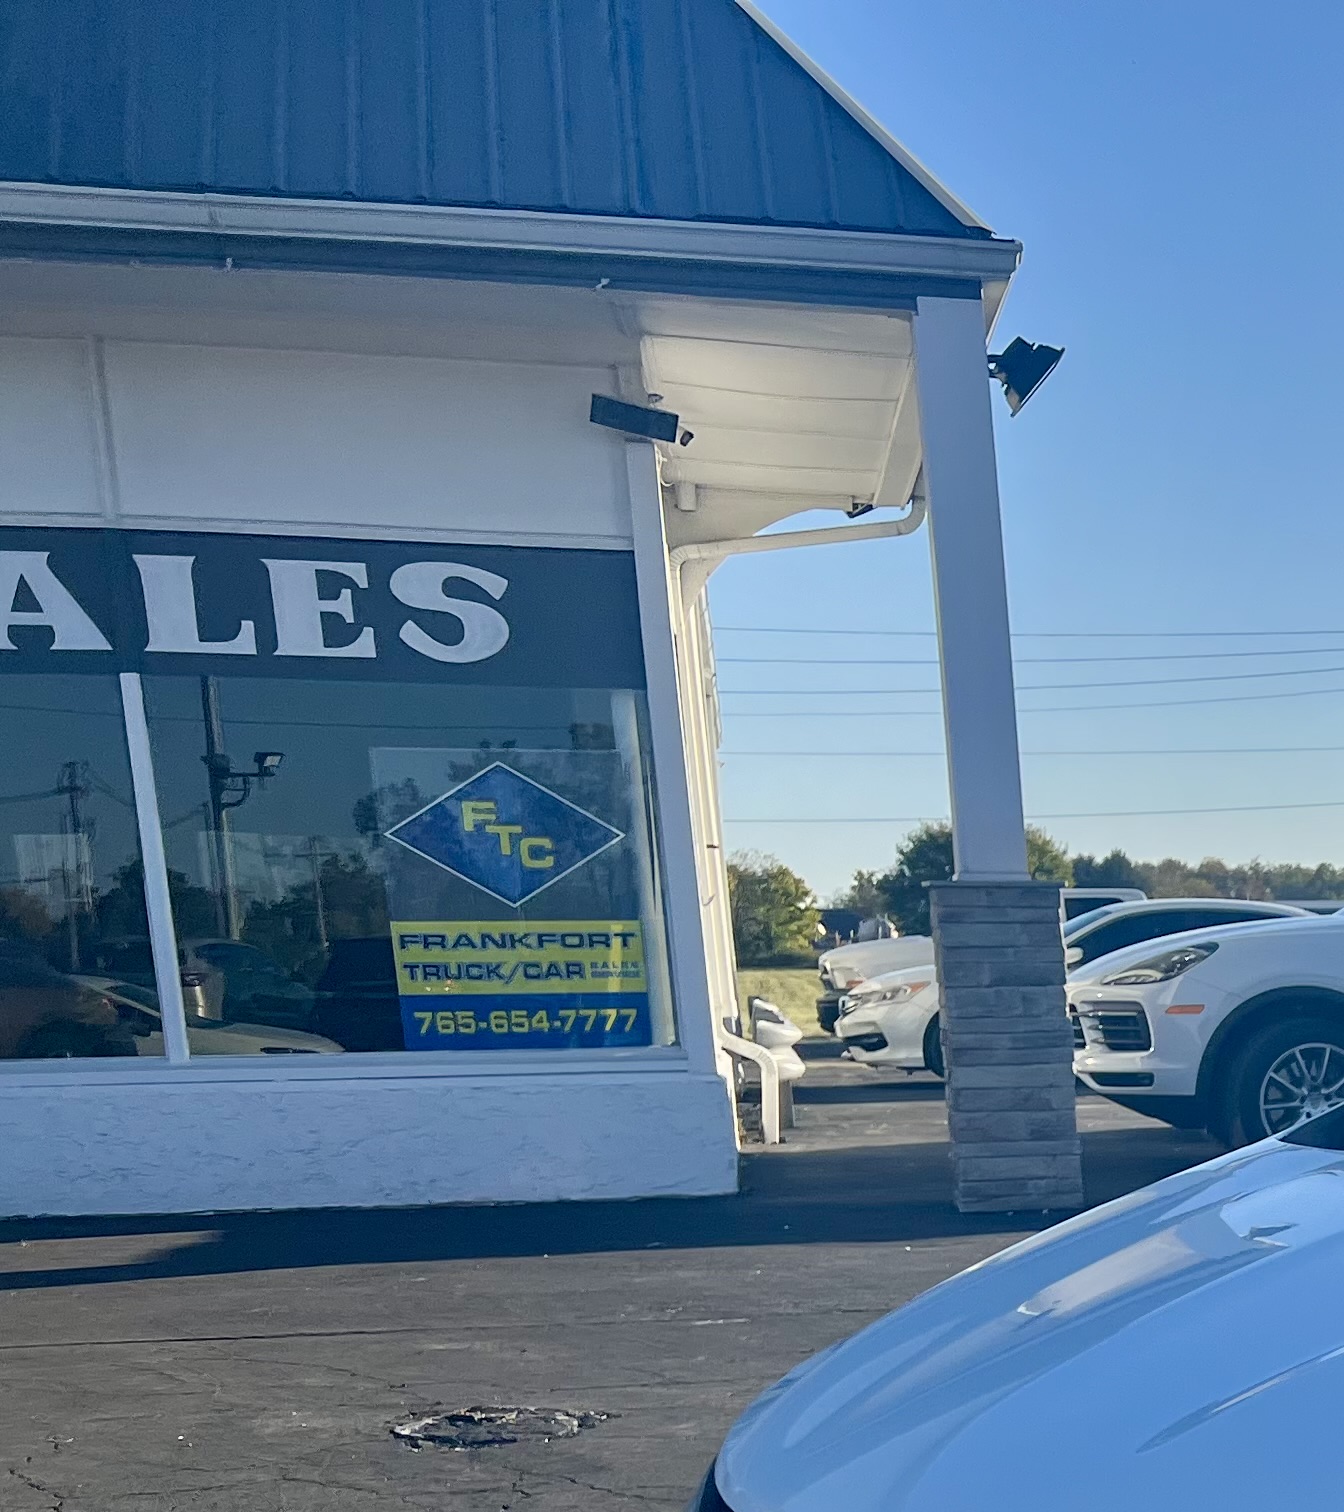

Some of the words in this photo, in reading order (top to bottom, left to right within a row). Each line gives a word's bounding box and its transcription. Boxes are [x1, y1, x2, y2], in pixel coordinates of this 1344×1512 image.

[0, 550, 510, 664] ALES
[461, 800, 555, 869] FTC
[400, 933, 635, 950] FRANKFORT
[404, 962, 586, 983] TRUCK/CAR
[414, 1010, 638, 1034] 765-654-7777
